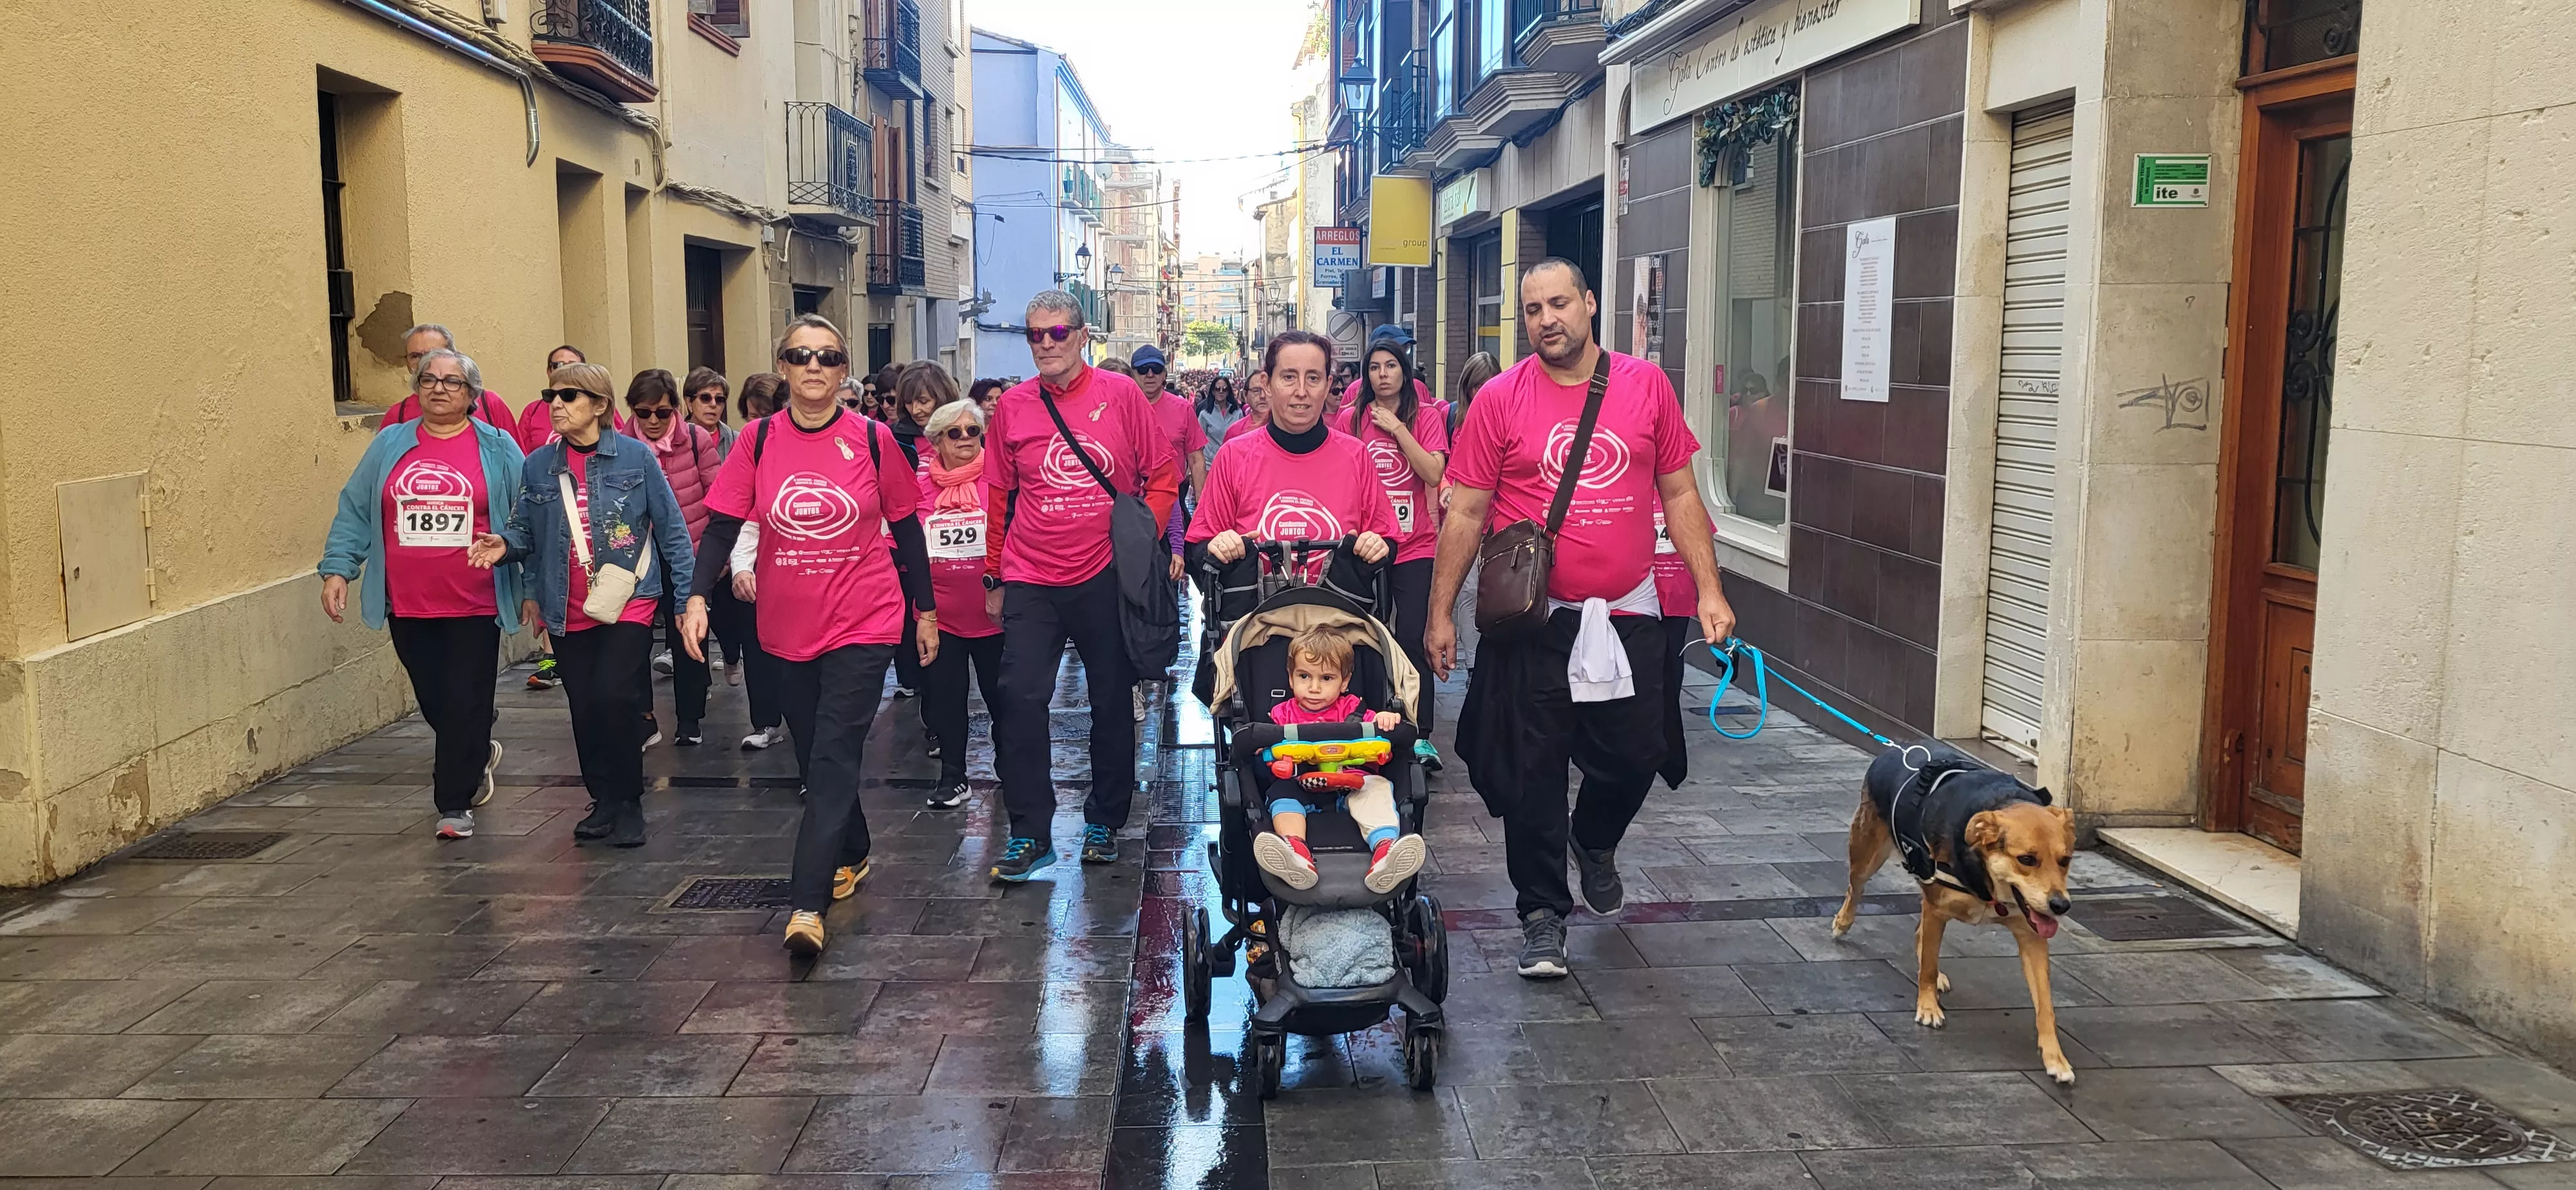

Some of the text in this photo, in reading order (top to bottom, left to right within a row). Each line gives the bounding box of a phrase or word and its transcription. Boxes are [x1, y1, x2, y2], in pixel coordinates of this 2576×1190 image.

[1663, 0, 1841, 115] Gala Centro de estética y bienestar
[2156, 187, 2178, 199] ite
[1316, 230, 1359, 241] ARREGLOS
[1403, 240, 1427, 248] group
[1332, 247, 1343, 255] EL
[1317, 258, 1358, 266] CARMEN
[795, 507, 820, 516] JUNTOS
[406, 513, 465, 532] 1897
[940, 527, 977, 546] 529
[1280, 527, 1305, 536] JUNTOS
